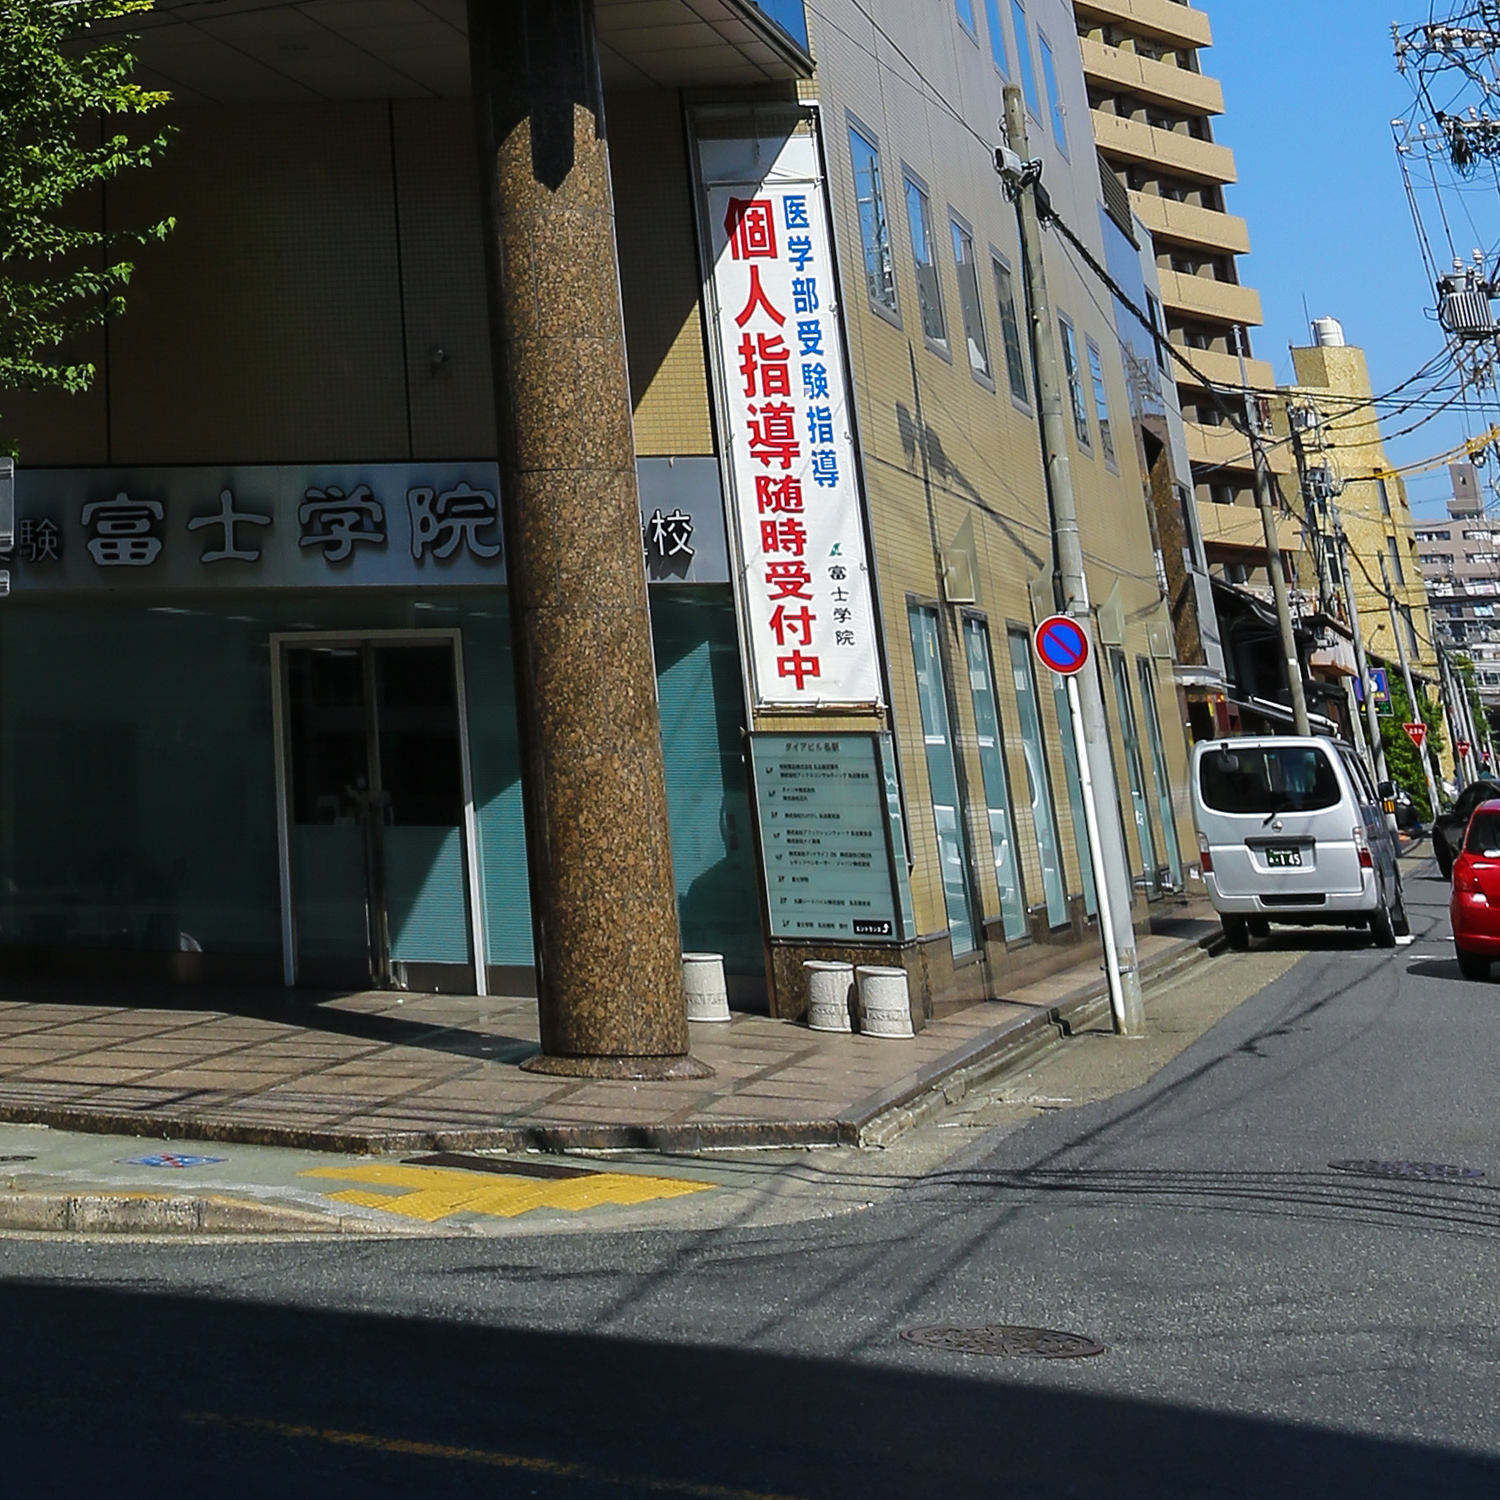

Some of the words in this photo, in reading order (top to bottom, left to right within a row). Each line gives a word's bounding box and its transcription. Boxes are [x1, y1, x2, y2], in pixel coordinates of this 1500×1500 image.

[783, 195, 839, 489] 医学部受験指導
[723, 196, 821, 690] 個人指導随時受付中
[81, 484, 500, 565] 富士学院
[641, 508, 695, 557] 校
[827, 563, 856, 647] 富士学院
